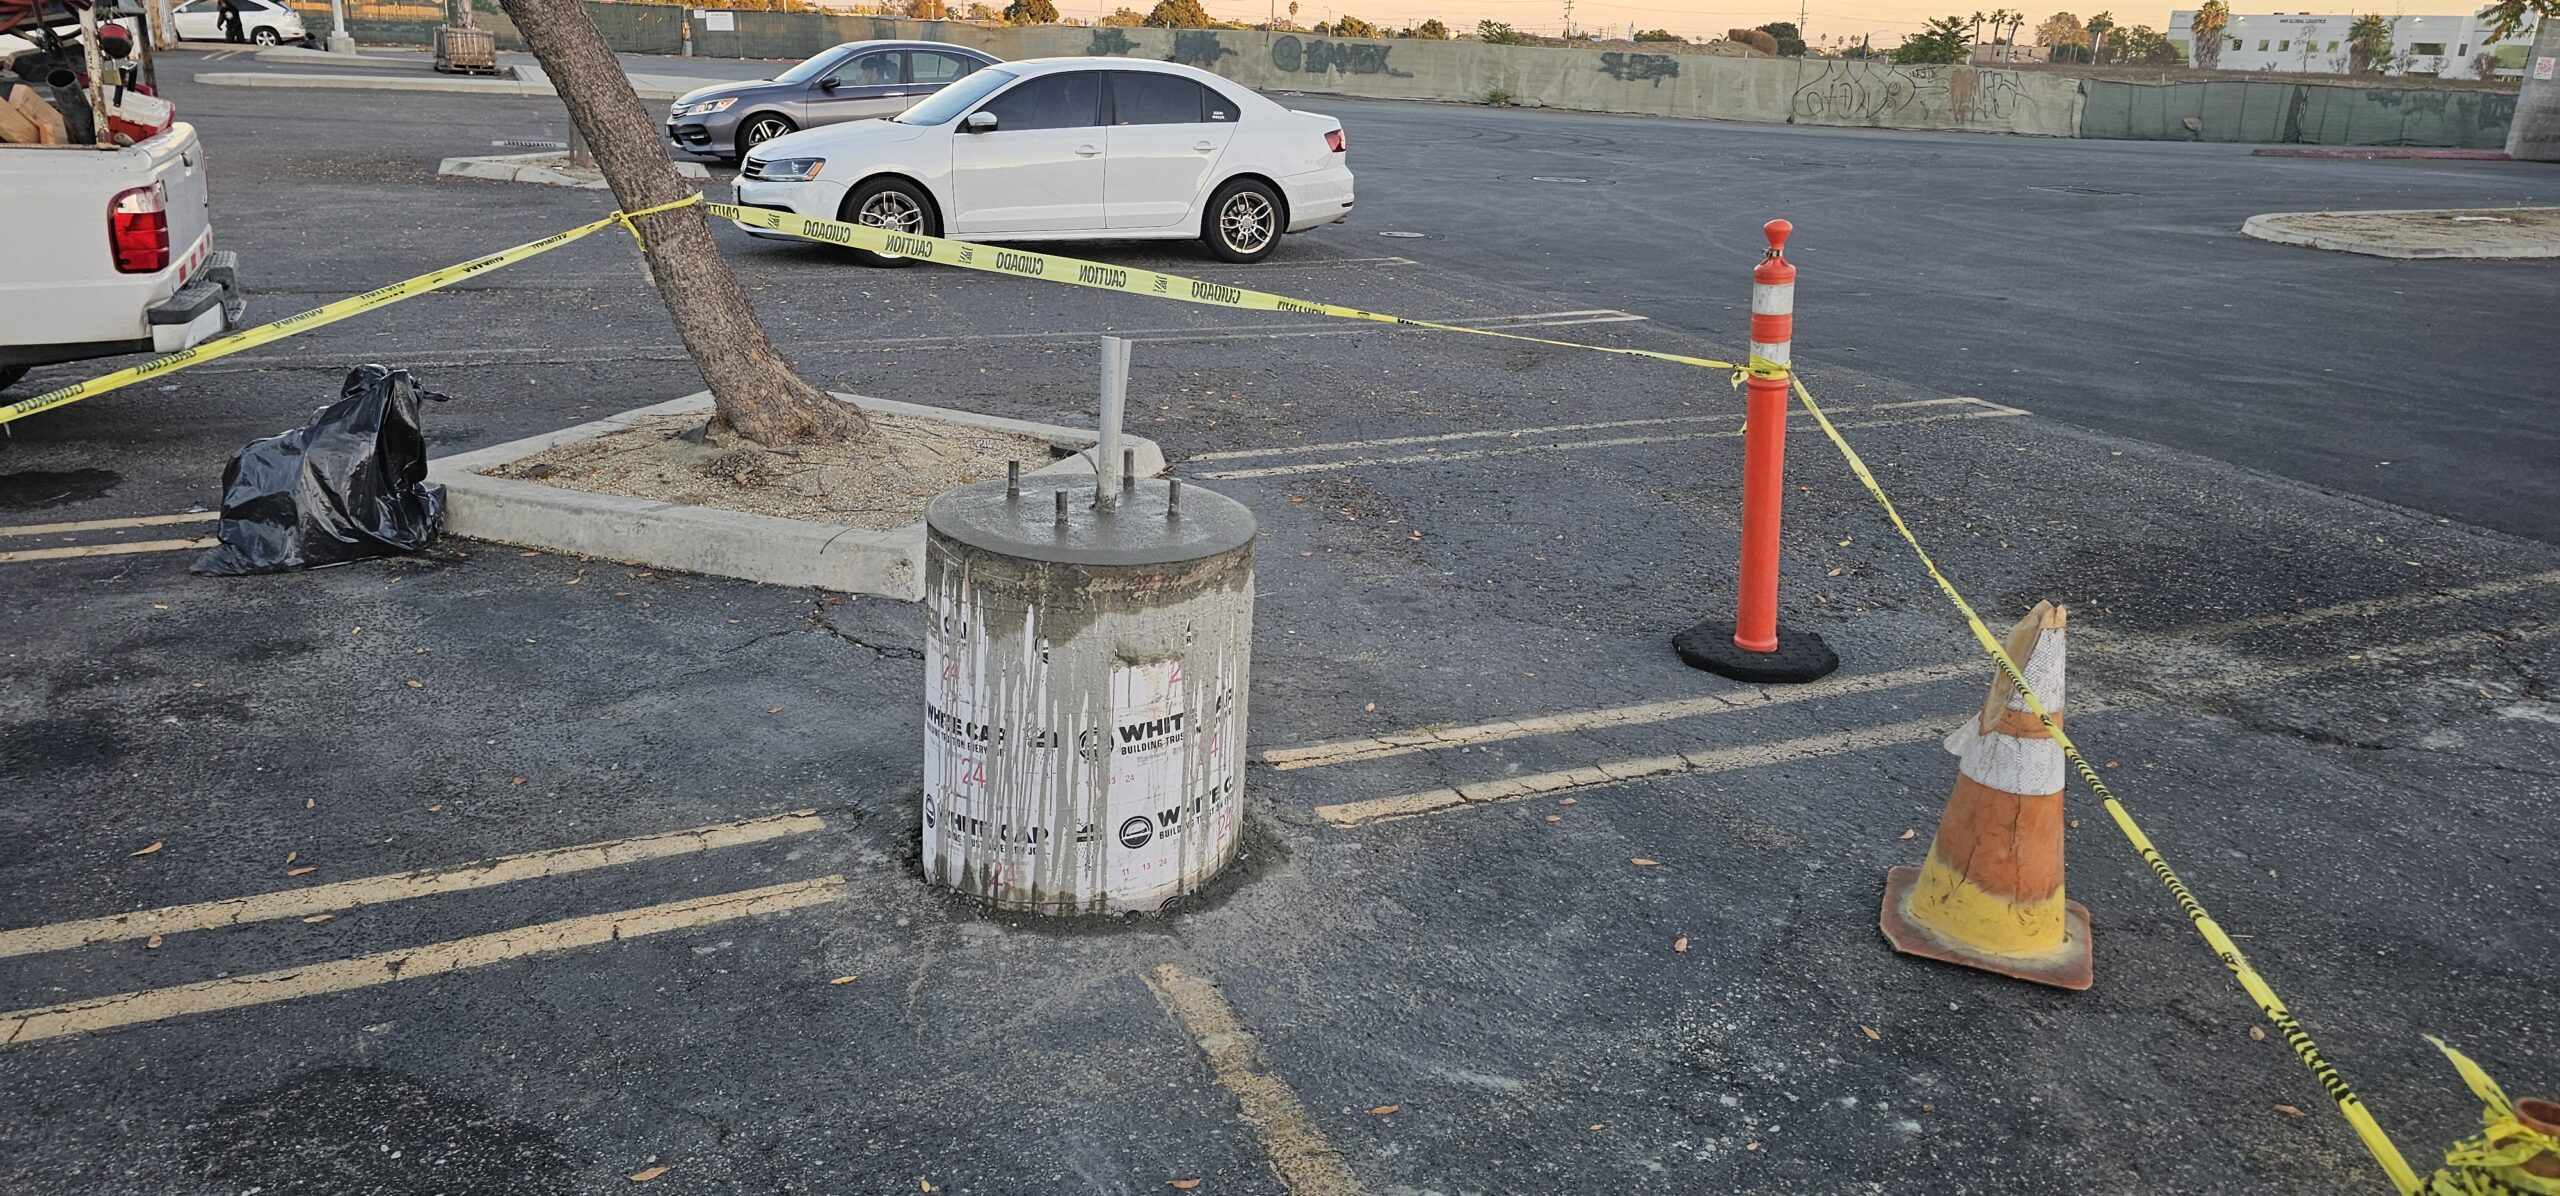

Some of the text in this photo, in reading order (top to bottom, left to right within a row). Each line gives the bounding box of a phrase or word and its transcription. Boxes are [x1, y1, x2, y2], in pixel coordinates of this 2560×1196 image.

[1119, 712, 1184, 744] WHIT
[1121, 738, 1163, 756] BUILDING
[961, 757, 987, 789] 24
[1125, 774, 1136, 783] 24
[1141, 862, 1151, 871] 13
